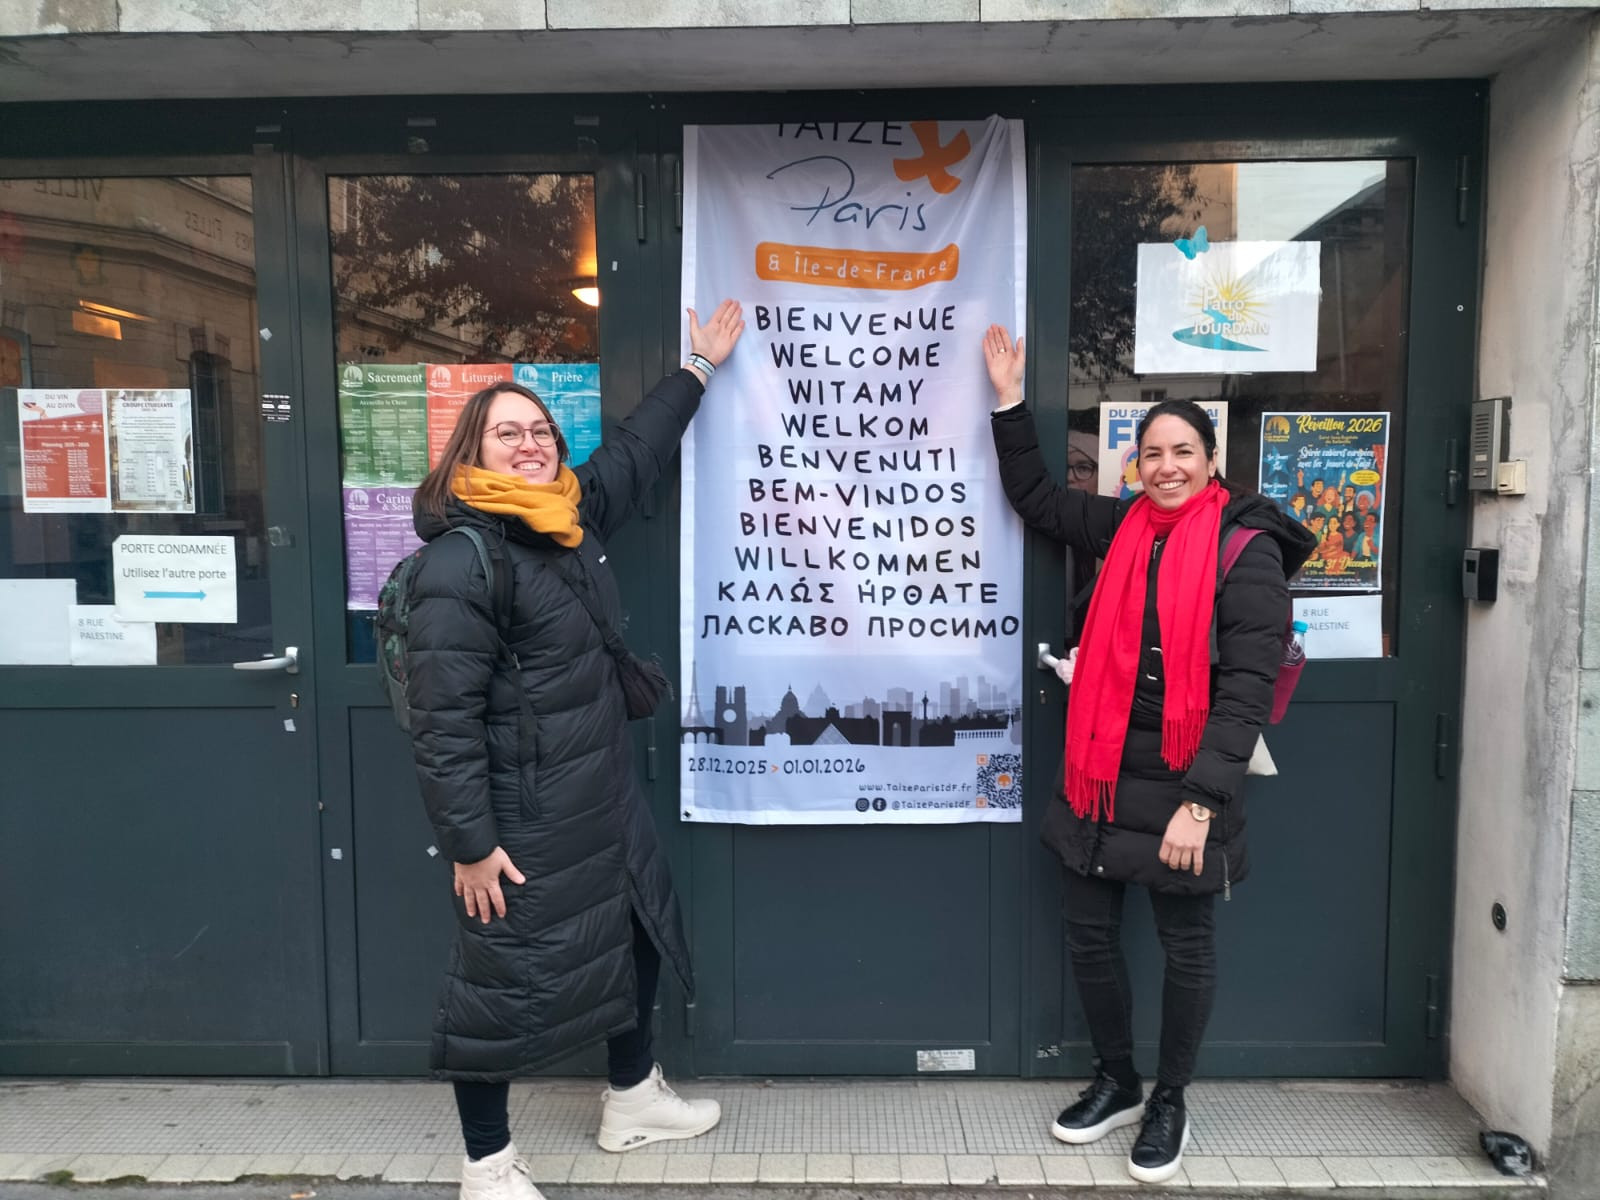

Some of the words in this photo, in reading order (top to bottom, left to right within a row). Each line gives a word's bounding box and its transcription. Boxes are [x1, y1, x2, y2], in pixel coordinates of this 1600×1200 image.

[766, 155, 926, 231] Paris
[794, 251, 947, 281] Île-de-France
[755, 305, 956, 335] BIENVENUE
[1192, 320, 1270, 336] JOURDAIN
[770, 342, 940, 370] WELCOME
[367, 372, 423, 383] Sacrement
[462, 372, 503, 385] Liturgie
[551, 371, 583, 383] Prière
[788, 378, 924, 406] WITAMY
[1109, 409, 1127, 418] DU
[781, 413, 928, 440] WELKOM
[1296, 415, 1345, 433] Réveillon
[1346, 418, 1383, 433] 2026
[758, 444, 956, 473] BENVENUTI
[376, 493, 414, 504] Carita
[749, 477, 966, 507] BEM-VINDOS
[740, 512, 976, 541] BIENVENIDOS
[121, 543, 155, 553] PORTE
[157, 541, 227, 554] CONDAMNÉE
[735, 546, 981, 575] WILLKOMMEN
[122, 568, 160, 578] Utilisez
[162, 568, 196, 578] l'autre
[199, 570, 227, 580] porte
[1310, 608, 1329, 617] RUE
[868, 615, 1019, 638] ПРОСИМО
[1309, 622, 1351, 631] ALESTINE
[80, 632, 125, 641] PALESTINE
[688, 757, 768, 774] 28.12.2025
[783, 758, 866, 775] 01.01.2026
